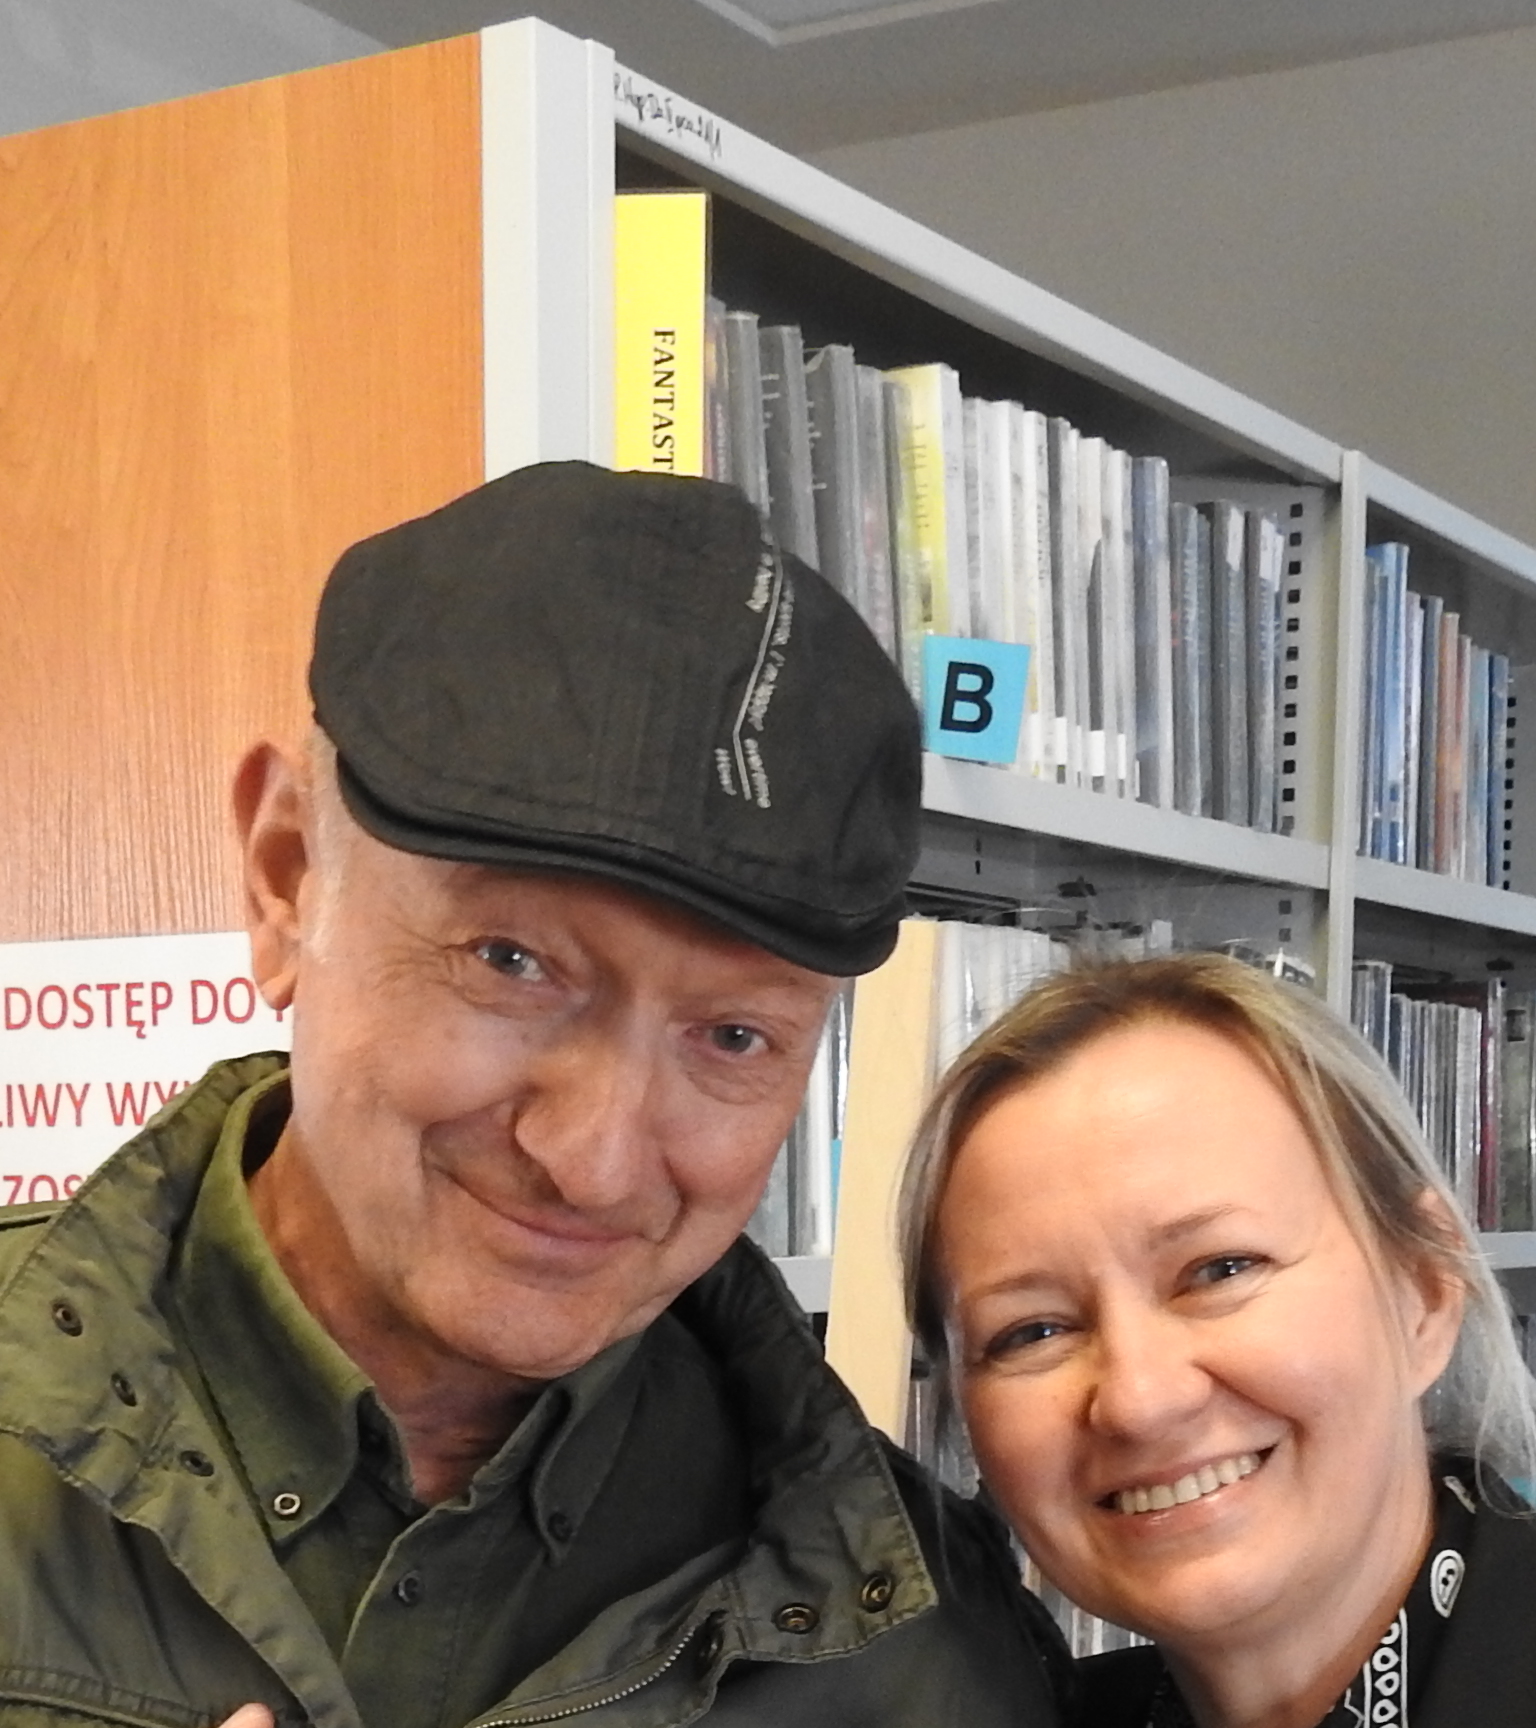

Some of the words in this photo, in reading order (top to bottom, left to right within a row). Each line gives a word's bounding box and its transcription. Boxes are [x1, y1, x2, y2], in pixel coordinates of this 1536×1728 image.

[652, 329, 675, 470] FANTAST
[938, 660, 995, 734] B
[4, 981, 174, 1039] DOSTĘP
[189, 977, 256, 1026] DO
[105, 1080, 193, 1127] WY
